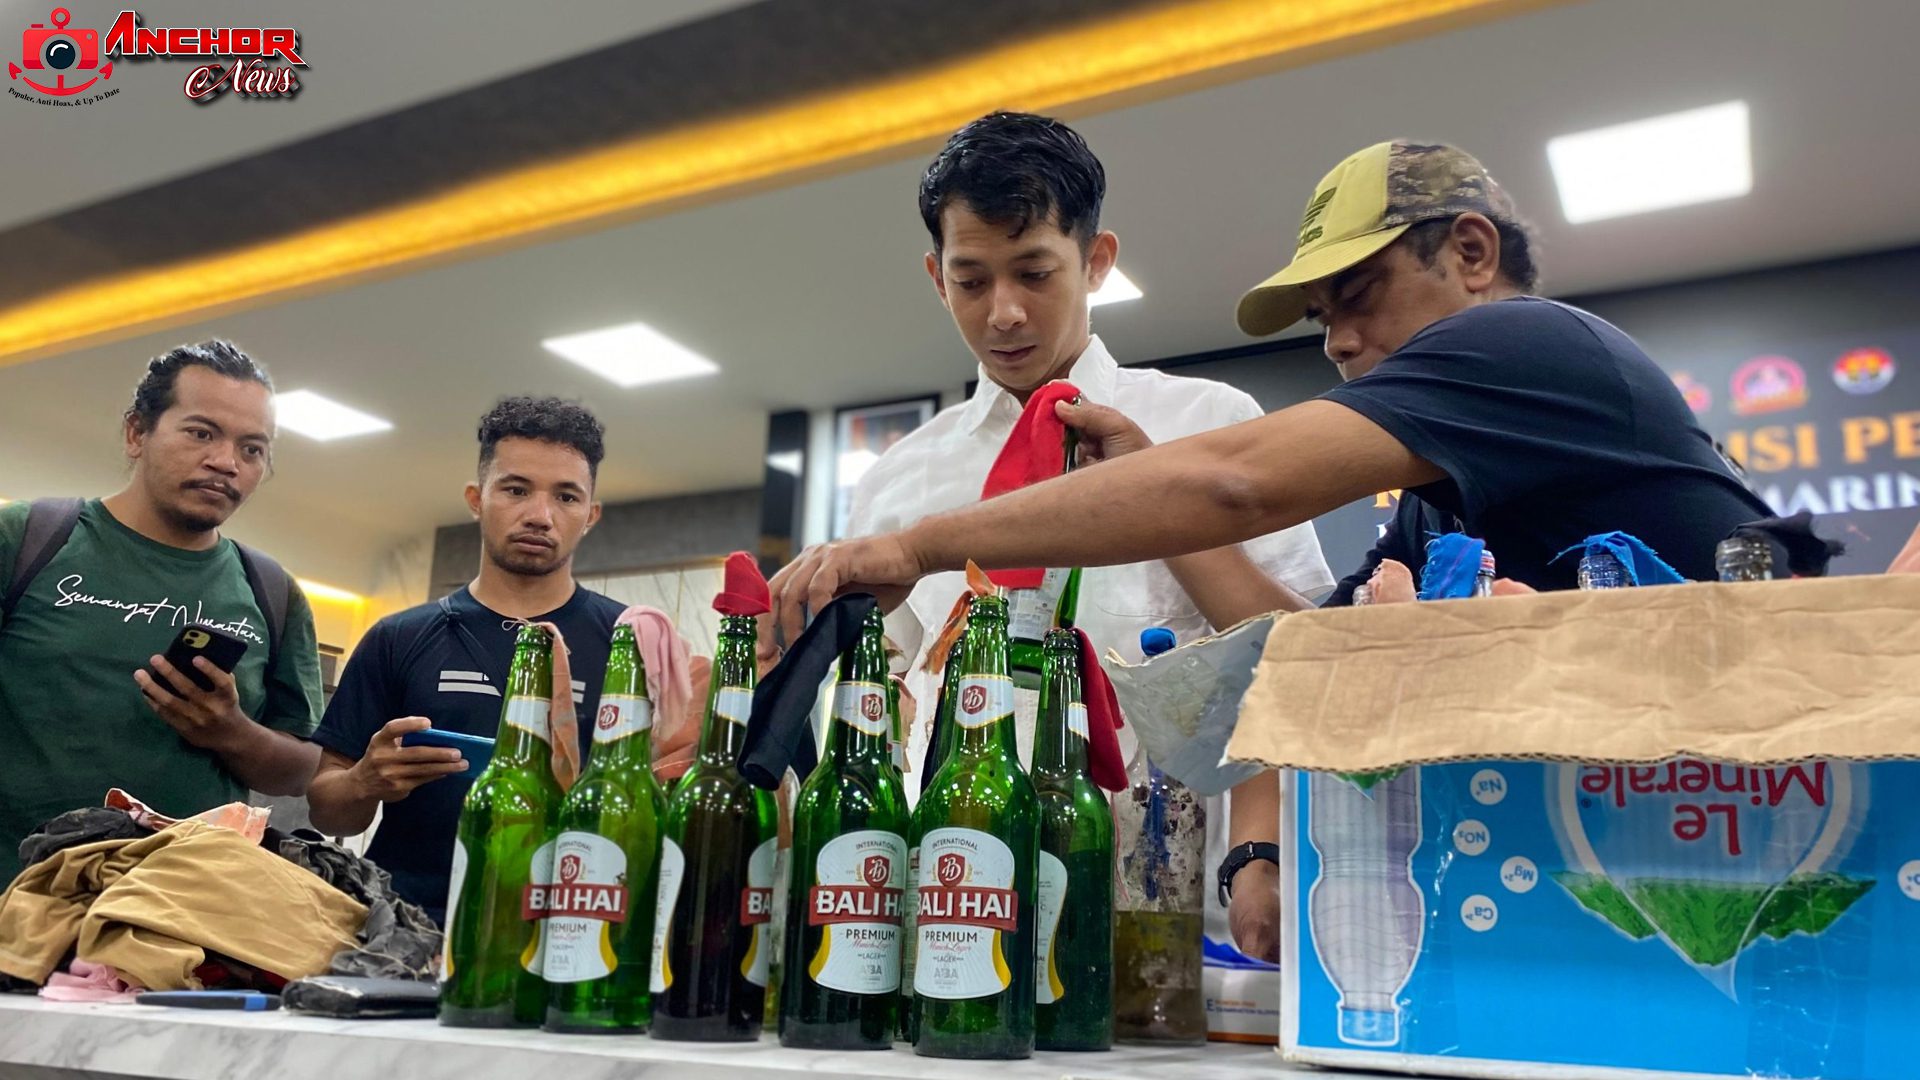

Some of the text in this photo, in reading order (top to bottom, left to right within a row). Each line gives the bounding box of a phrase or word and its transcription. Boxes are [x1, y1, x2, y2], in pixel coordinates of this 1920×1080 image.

[55, 574, 176, 624] Semangat
[1581, 760, 1827, 807] Minerale
[1673, 804, 1742, 856] Le
[932, 838, 979, 851] INTERNATIONAL
[573, 888, 622, 912] HAI
[816, 889, 880, 916] BALI
[959, 891, 1011, 919] HAI
[846, 928, 896, 941] PREMIUM
[925, 930, 978, 943] PREMIUM
